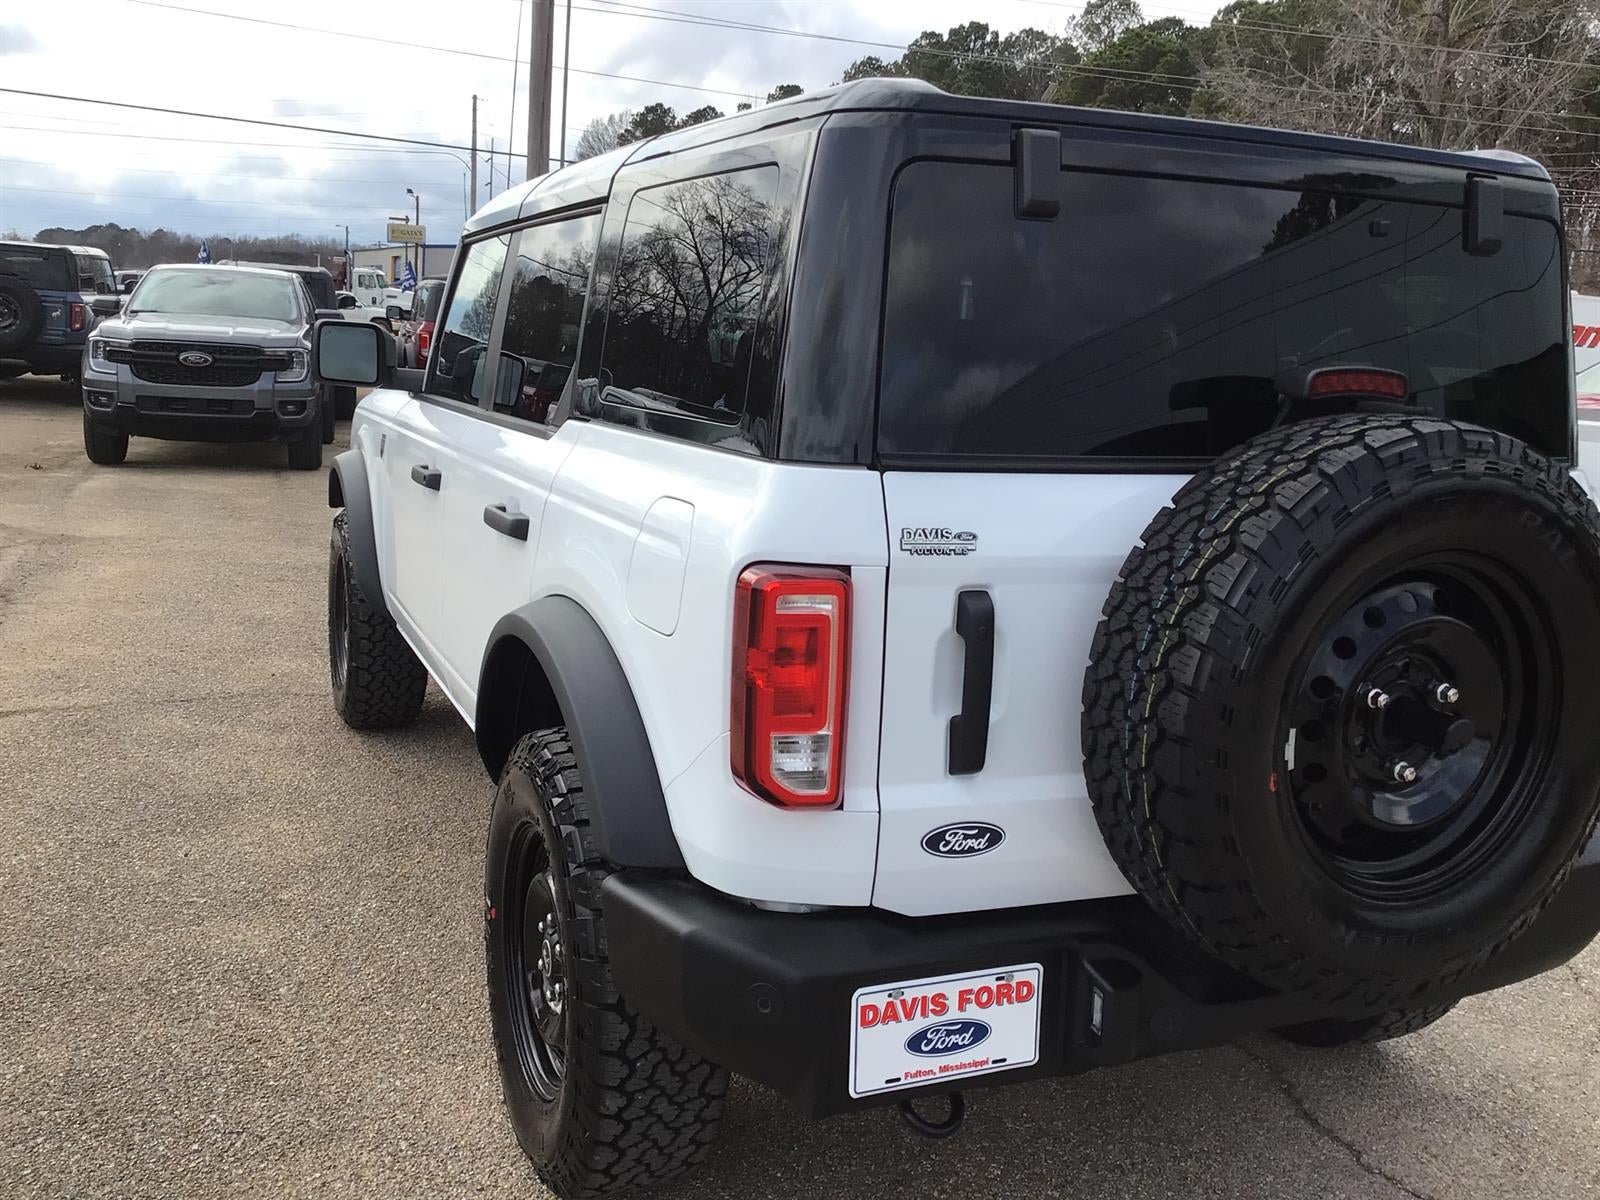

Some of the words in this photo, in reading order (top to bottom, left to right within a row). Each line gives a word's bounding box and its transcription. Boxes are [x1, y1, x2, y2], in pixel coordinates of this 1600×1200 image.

[901, 528, 953, 542] DAVIS
[938, 828, 991, 852] Ford
[859, 992, 950, 1030] DAVIS
[957, 979, 1036, 1013] FORD
[920, 1023, 976, 1052] Ford
[903, 1067, 937, 1081] Fulton,
[937, 1056, 990, 1074] Mississippi
